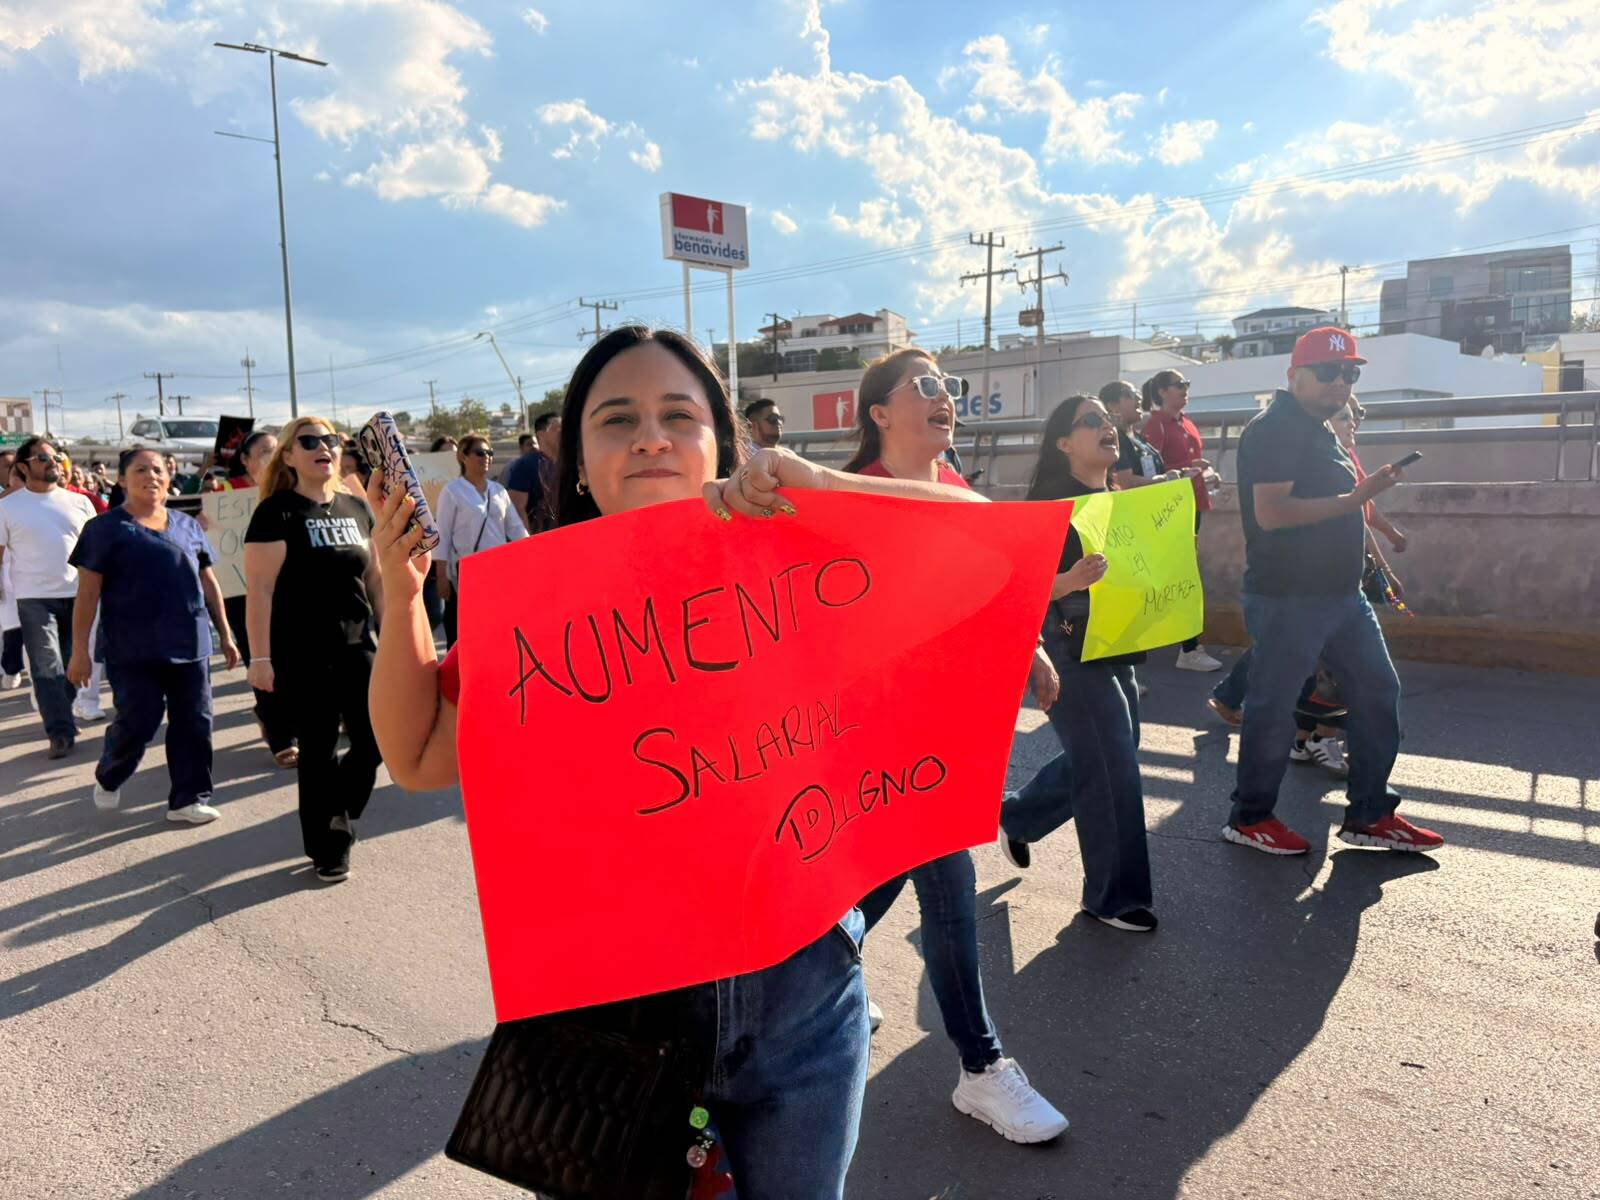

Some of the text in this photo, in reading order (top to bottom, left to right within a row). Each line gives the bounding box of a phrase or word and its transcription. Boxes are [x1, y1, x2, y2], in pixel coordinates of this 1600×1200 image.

[674, 234, 745, 260] benavides
[1329, 334, 1345, 352] NY
[304, 517, 357, 529] CALVIN
[308, 527, 365, 548] KLEIN
[508, 558, 871, 725] AUMENTO
[633, 694, 860, 815] SALARIAL
